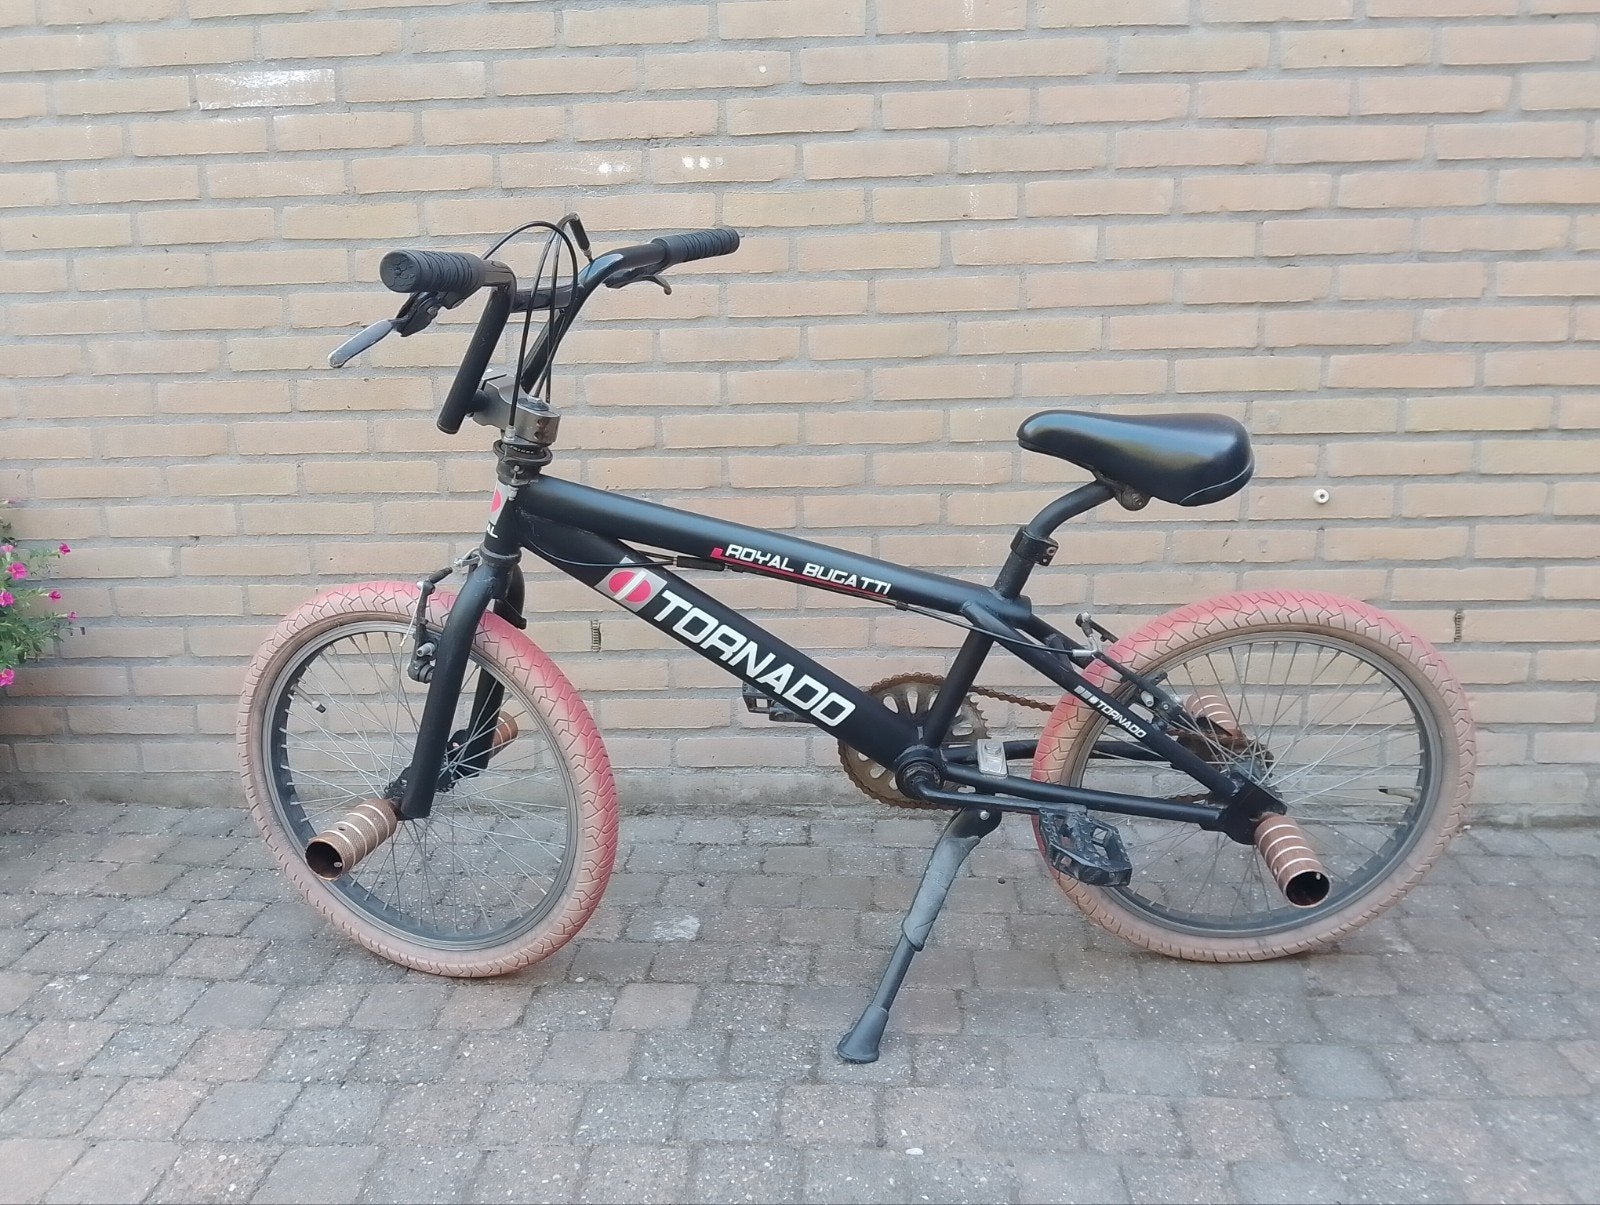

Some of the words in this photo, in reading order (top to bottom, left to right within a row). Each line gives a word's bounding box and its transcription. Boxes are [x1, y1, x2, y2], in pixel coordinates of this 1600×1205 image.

[724, 544, 795, 572] ROYAL
[802, 562, 892, 596] BUGATTI
[653, 589, 857, 727] TORNADO
[1096, 700, 1148, 739] TORNADO
